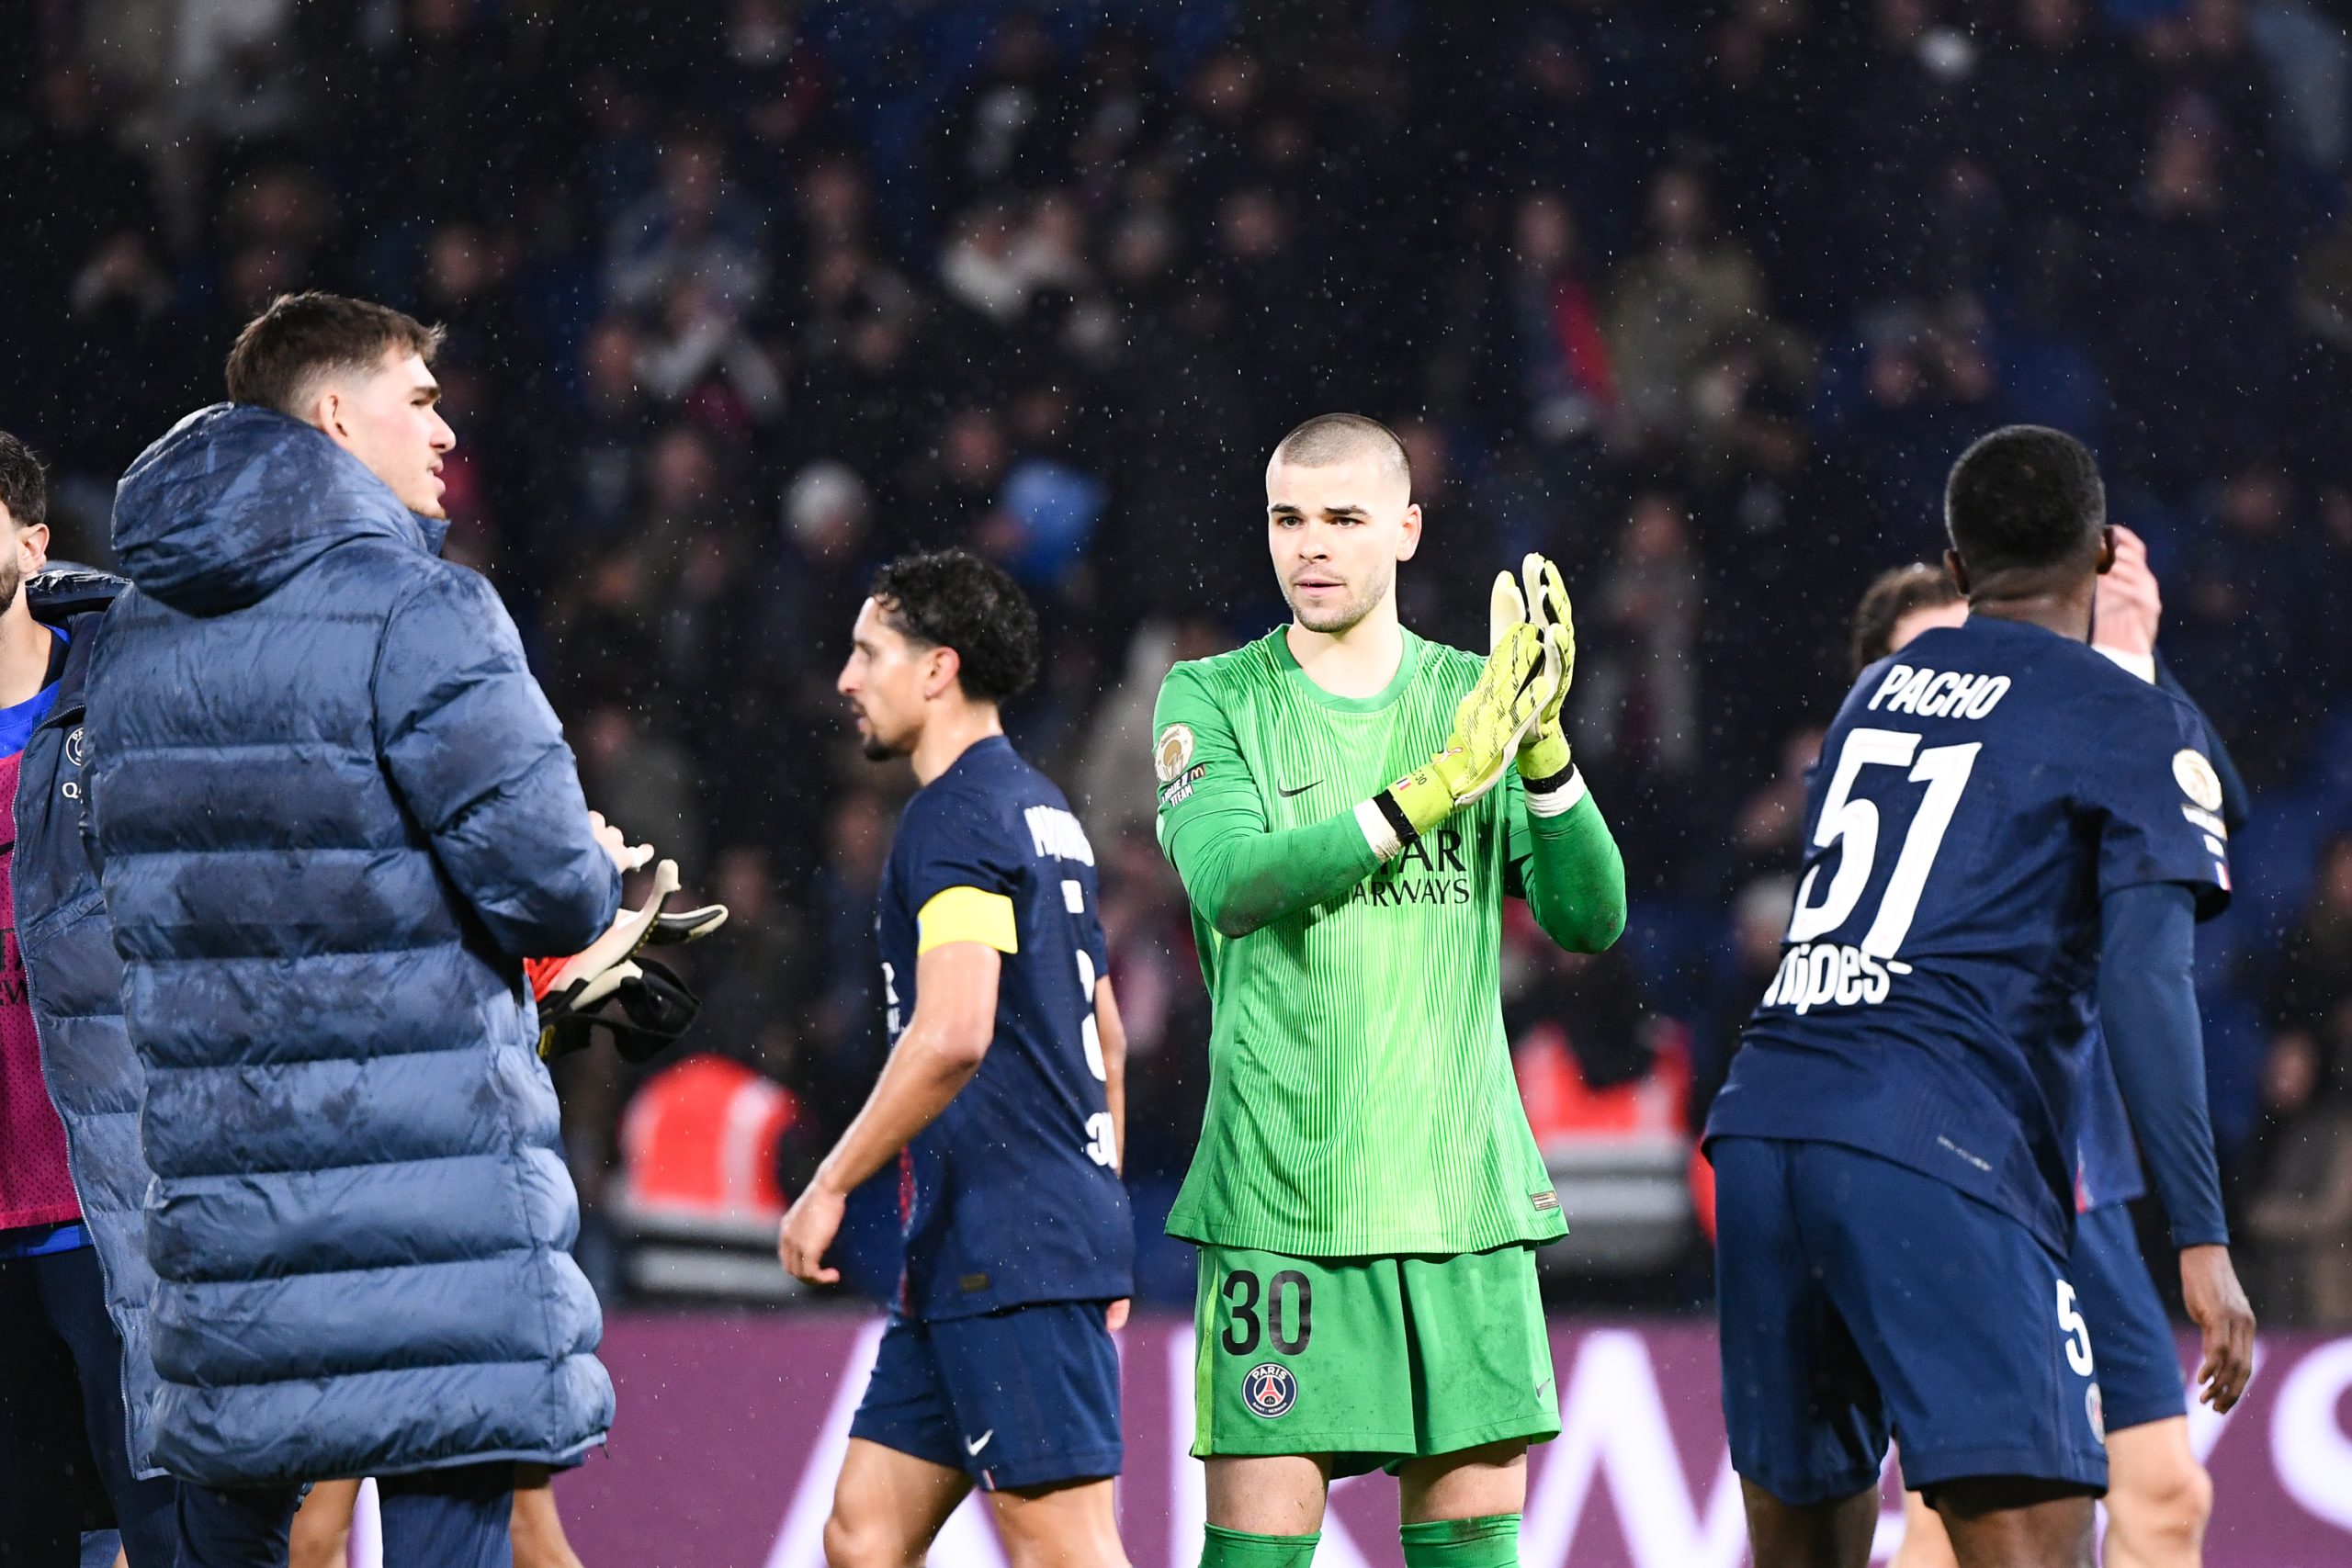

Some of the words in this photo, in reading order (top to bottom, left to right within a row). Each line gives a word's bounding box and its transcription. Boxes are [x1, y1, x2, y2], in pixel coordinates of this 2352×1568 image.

[1867, 664, 2012, 720] PACHO
[1789, 728, 1983, 959] 51
[1222, 1269, 1312, 1356] 30
[1251, 1366, 1287, 1380] PARIS
